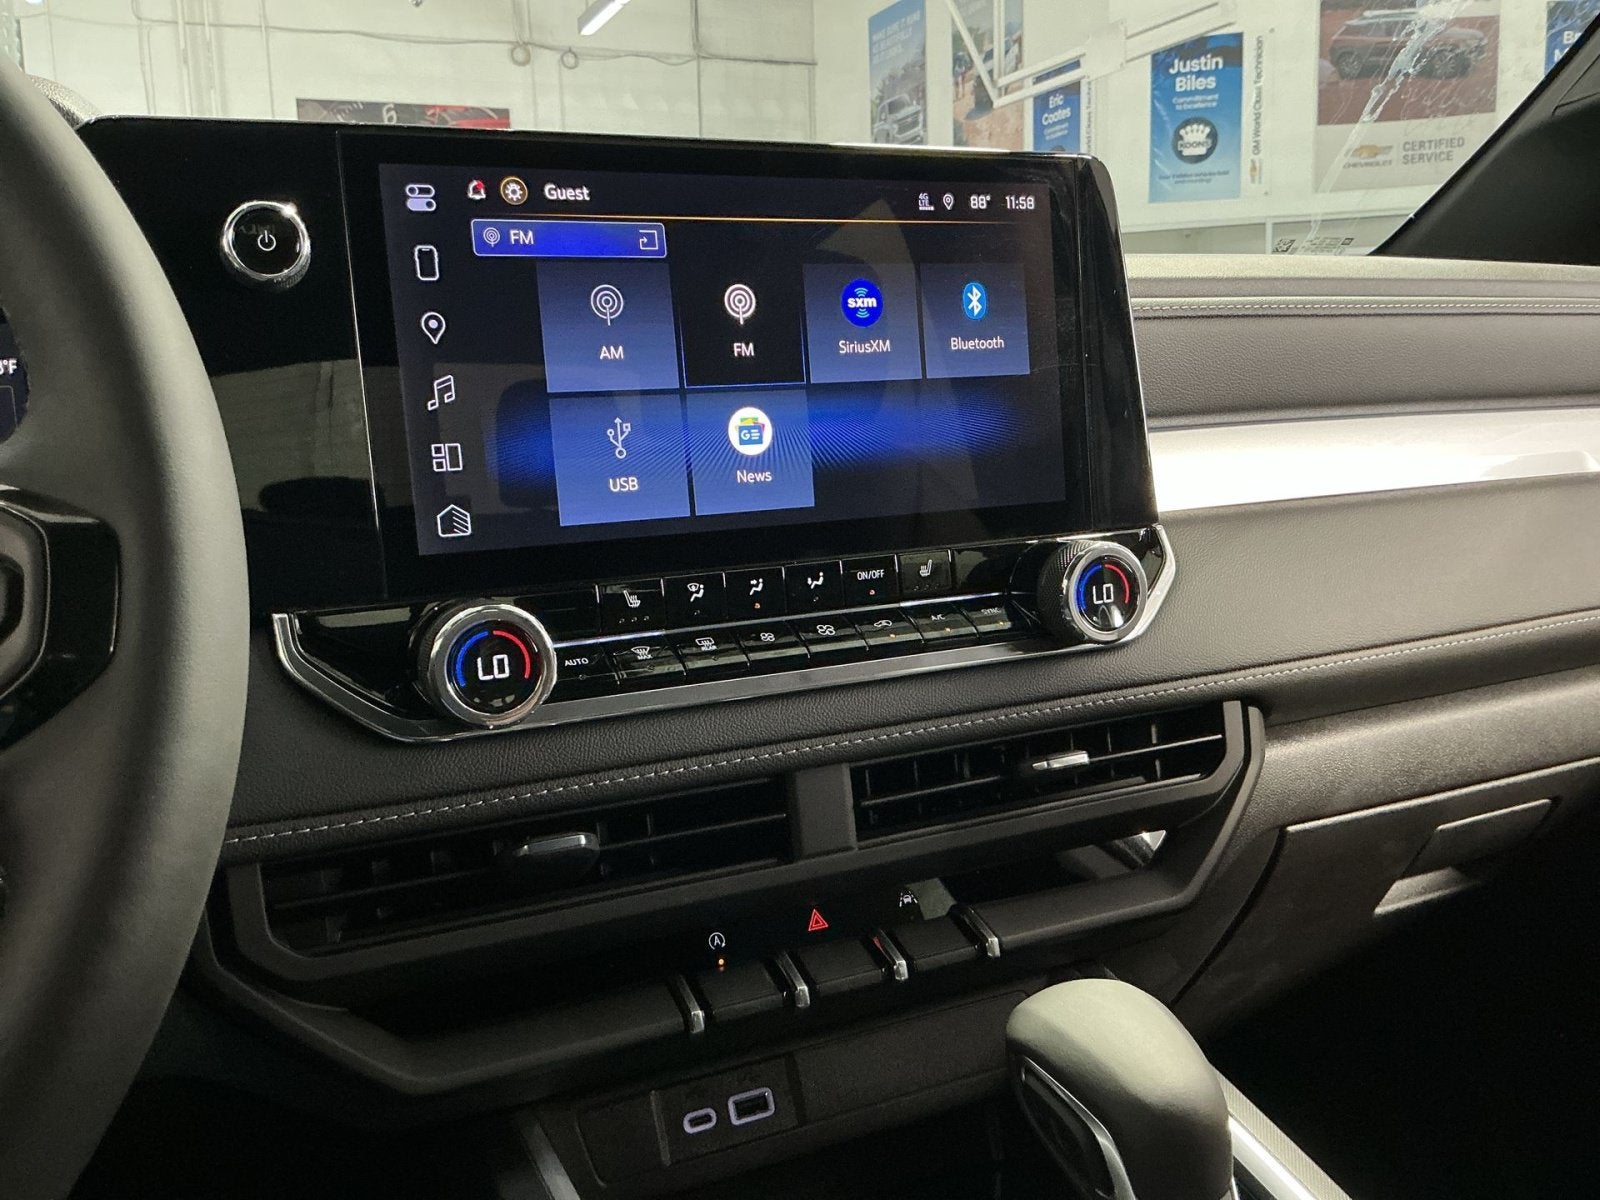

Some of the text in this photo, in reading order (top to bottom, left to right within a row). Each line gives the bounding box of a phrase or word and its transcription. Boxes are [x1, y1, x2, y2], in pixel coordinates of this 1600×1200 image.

[1168, 53, 1223, 74] Justin
[1175, 75, 1217, 92] Biles
[1049, 93, 1064, 109] Eric
[1252, 112, 1262, 139] World
[1251, 140, 1261, 155] GM
[1402, 136, 1465, 152] CERTIFIED
[1401, 150, 1454, 165] SERVICE
[543, 184, 591, 201] Guest
[1005, 195, 1036, 210] 11:58
[509, 230, 534, 245] FM
[847, 297, 877, 308] sxm
[733, 342, 755, 357] FM
[838, 339, 891, 354] SiriusXM
[950, 335, 1005, 350] Bluetooth
[599, 345, 624, 360] AM
[609, 476, 639, 492] USB
[736, 469, 773, 484] News
[856, 569, 885, 581] ON/OFF
[1092, 583, 1115, 605] LO
[981, 607, 1001, 615] SYNC
[476, 654, 510, 681] LO
[564, 657, 589, 667] AUTO
